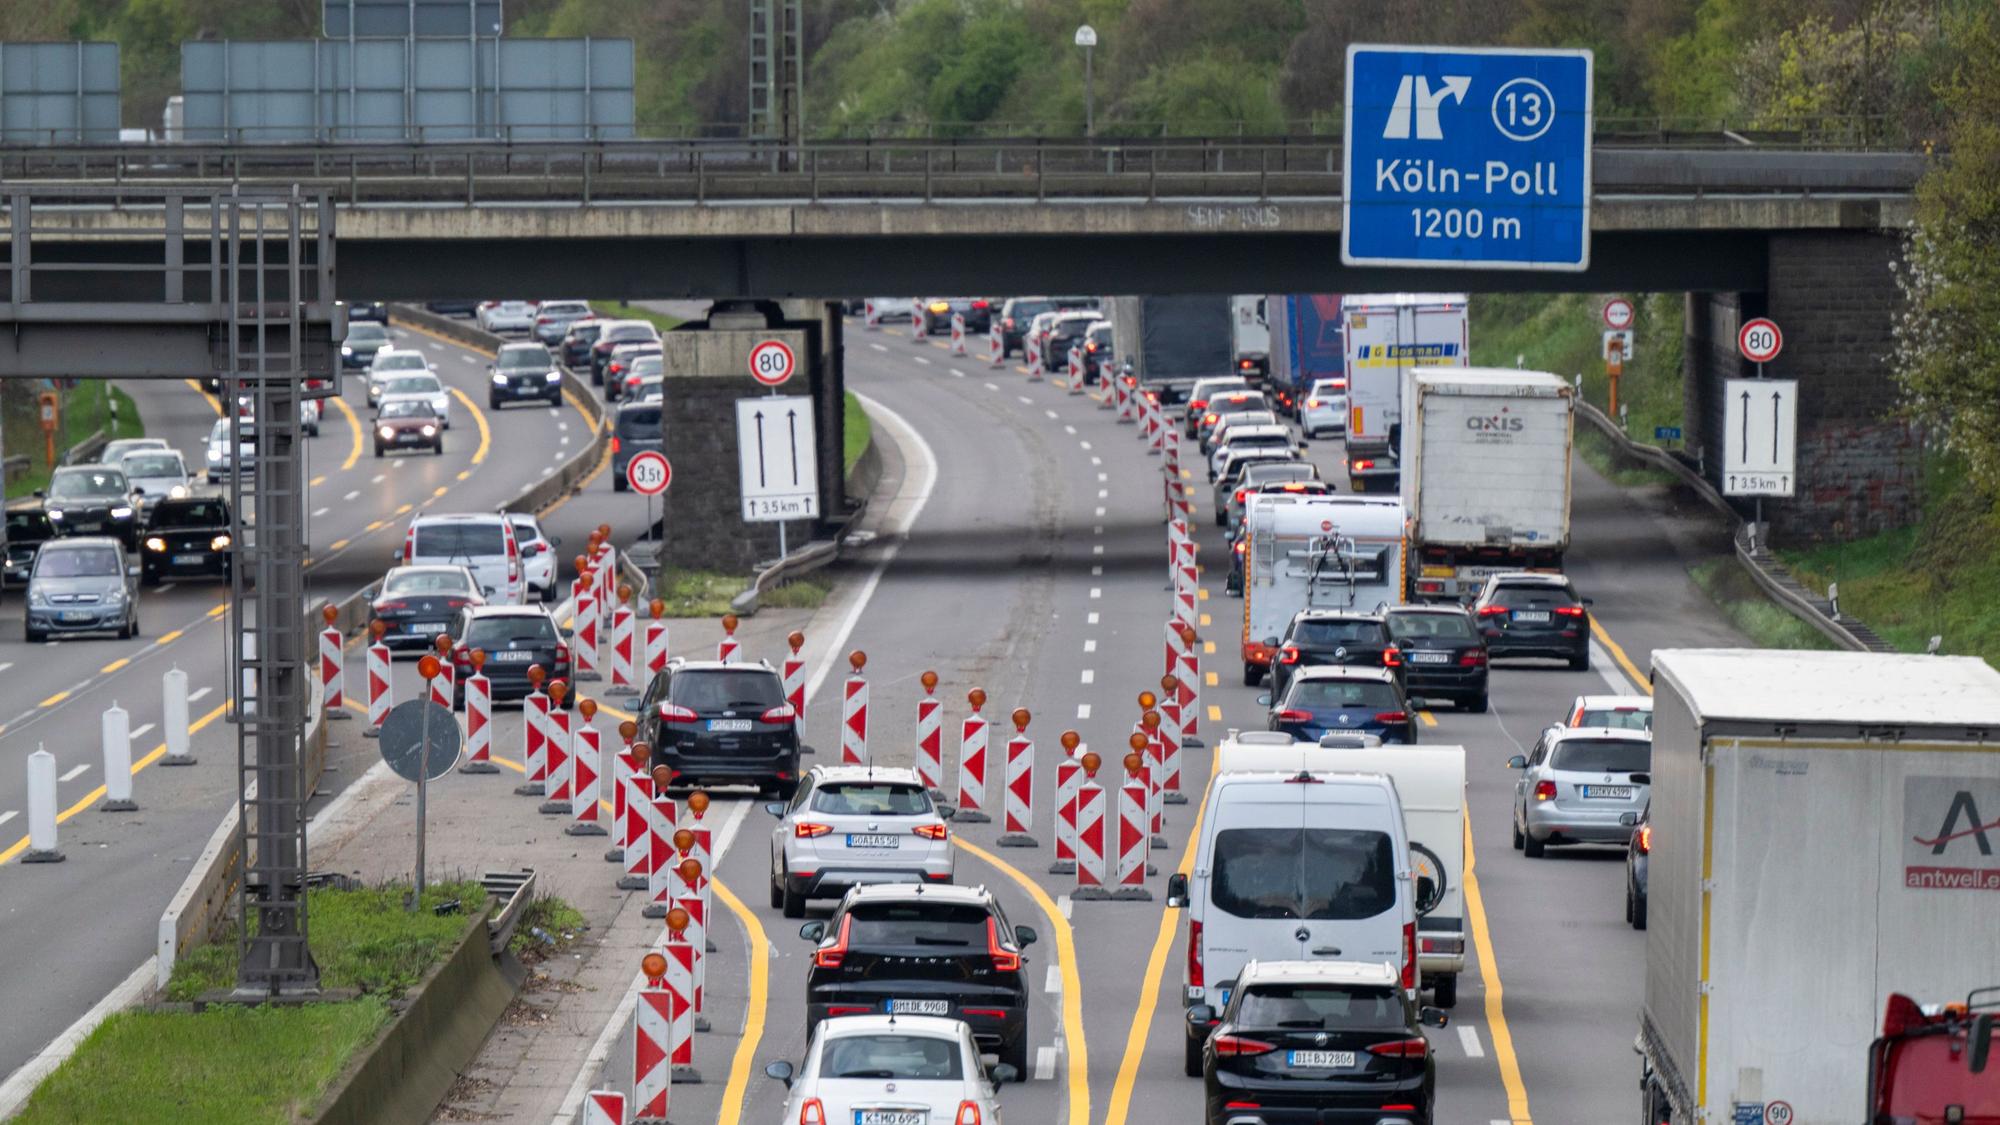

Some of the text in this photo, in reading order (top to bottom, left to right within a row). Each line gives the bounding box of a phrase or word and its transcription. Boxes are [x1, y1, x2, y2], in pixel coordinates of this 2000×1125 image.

[1505, 92, 1542, 127] 13
[1375, 158, 1558, 196] Köln-Poll
[1411, 208, 1521, 240] 1200 m
[1750, 331, 1772, 350] 80
[760, 352, 785, 373] 80
[1466, 407, 1524, 431] axis
[1741, 476, 1777, 490] 3,5 km
[761, 499, 799, 514] 3,5 km
[1771, 1106, 1788, 1120] 90
